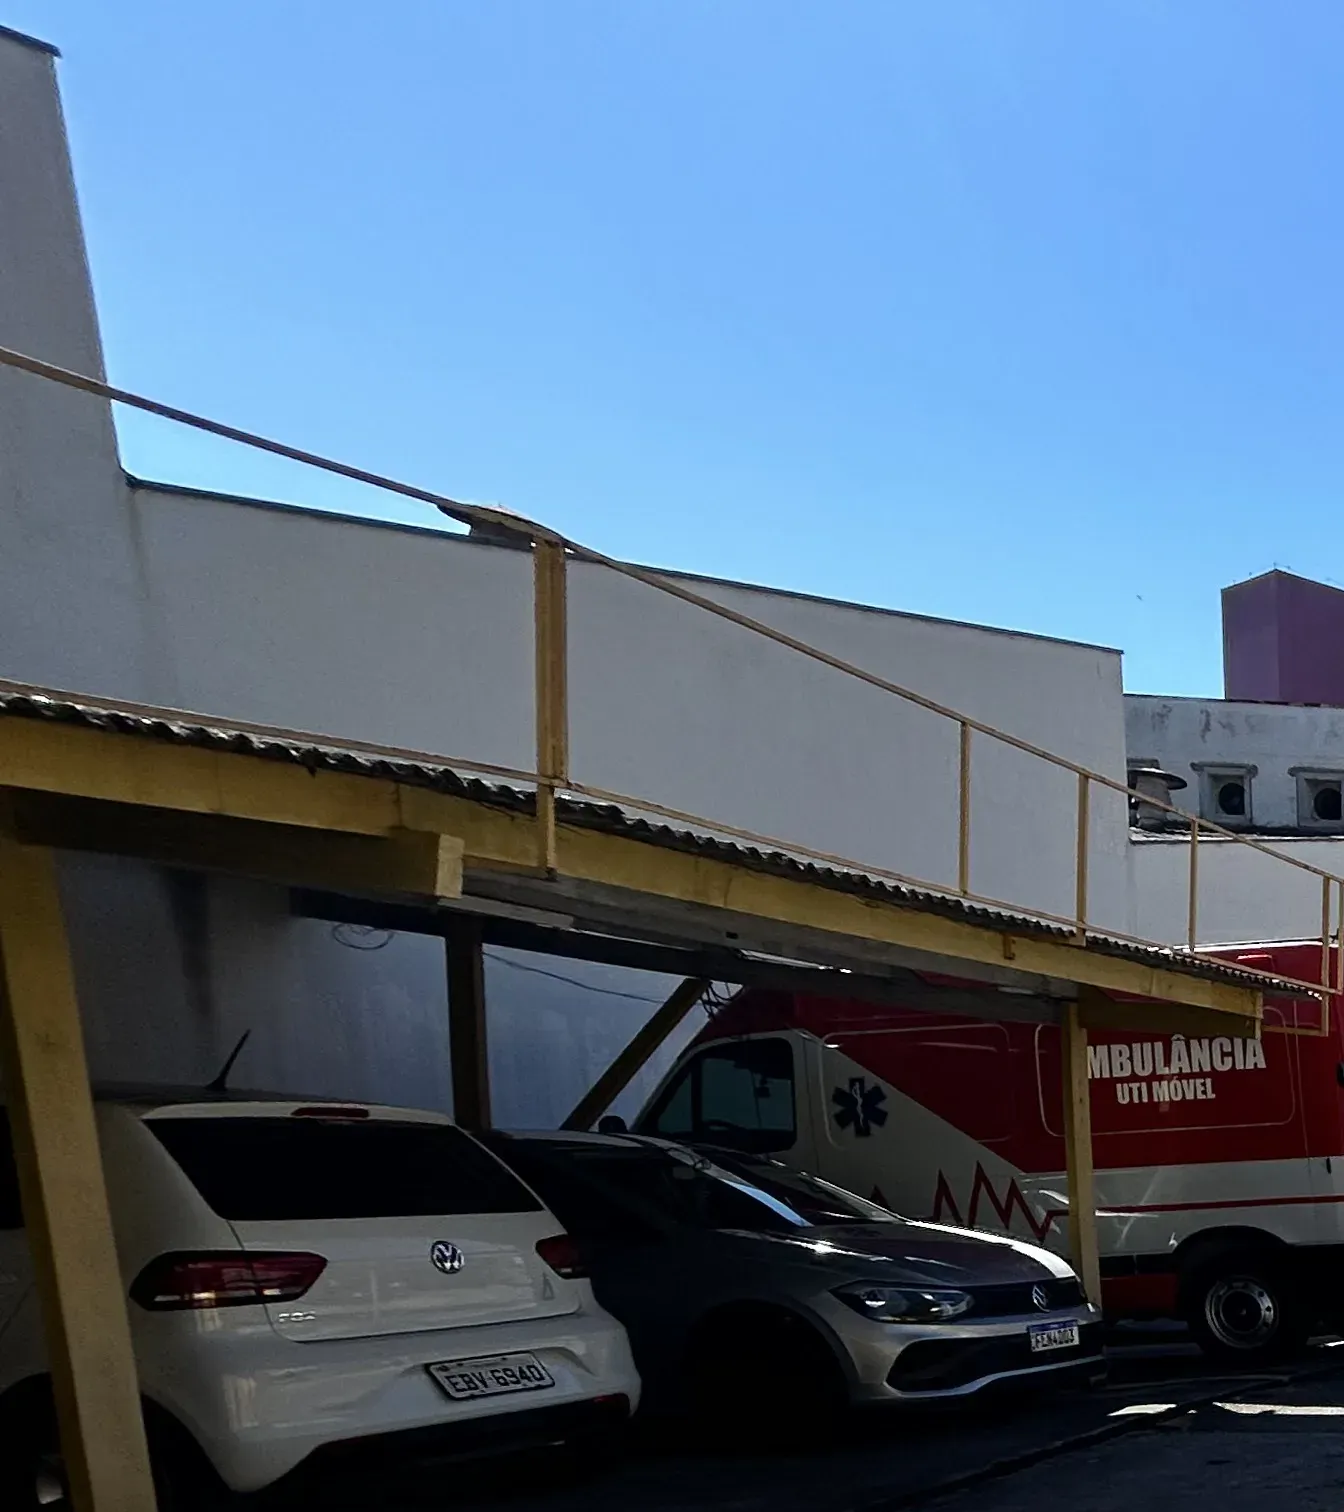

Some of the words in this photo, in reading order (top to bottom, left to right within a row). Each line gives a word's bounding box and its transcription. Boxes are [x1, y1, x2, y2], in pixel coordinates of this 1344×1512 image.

[1087, 1033, 1267, 1079] MBULÂNCIA
[1116, 1082, 1148, 1105] UTI
[1152, 1076, 1216, 1103] MÓVEL
